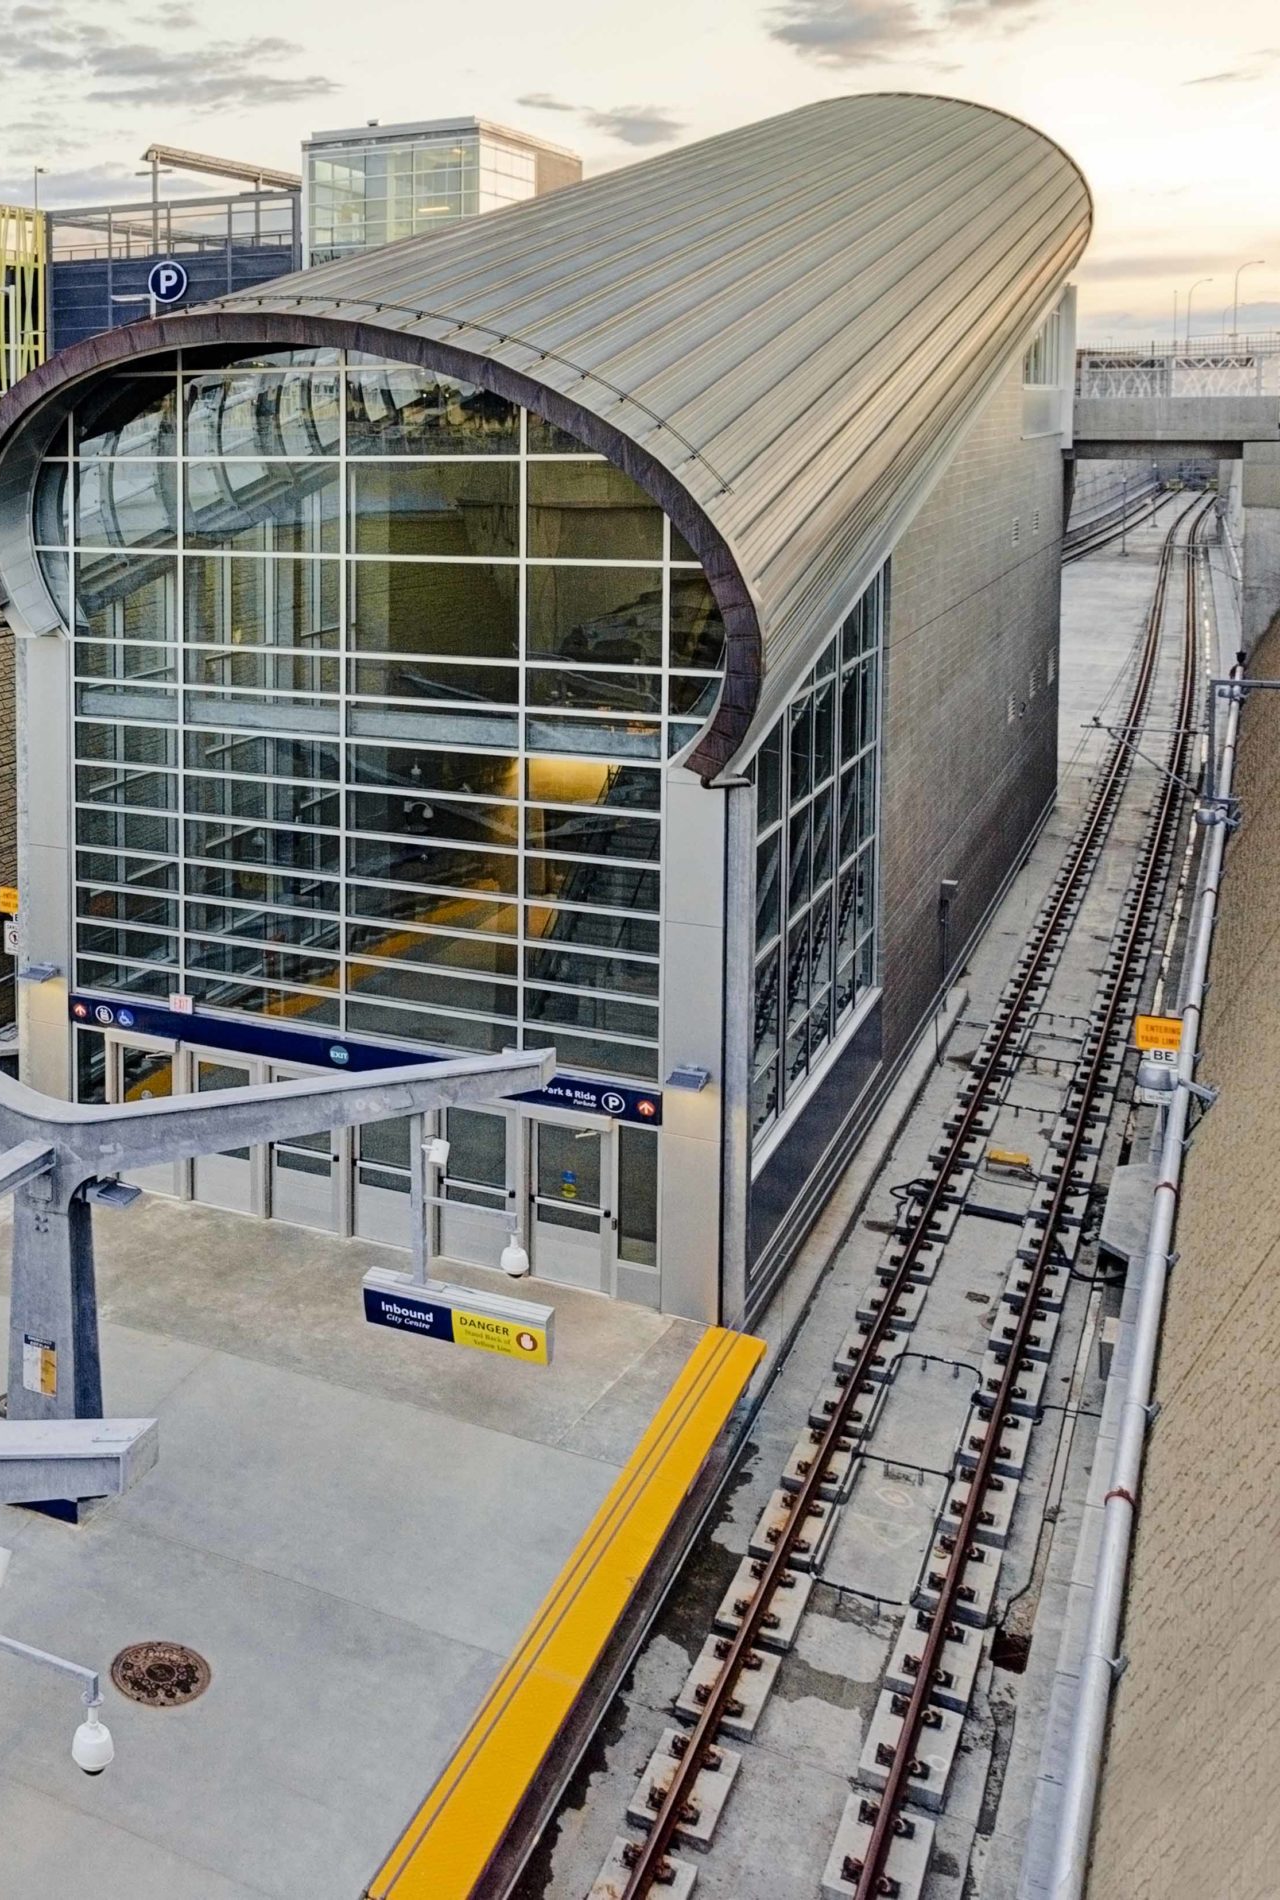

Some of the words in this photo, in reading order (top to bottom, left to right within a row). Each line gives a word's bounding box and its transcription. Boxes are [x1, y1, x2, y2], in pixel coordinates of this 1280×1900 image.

[160, 269, 178, 295] P
[1141, 1035, 1160, 1044] YARD
[330, 1050, 348, 1060] EXIT
[1153, 1050, 1174, 1061] BE
[542, 1085, 563, 1096] Park
[565, 1089, 573, 1097] &
[575, 1090, 597, 1101] Ride
[608, 1096, 620, 1109] P
[381, 1301, 434, 1323] Inbound
[386, 1313, 403, 1325] City
[404, 1318, 430, 1330] Centre
[459, 1316, 509, 1336] DANGER
